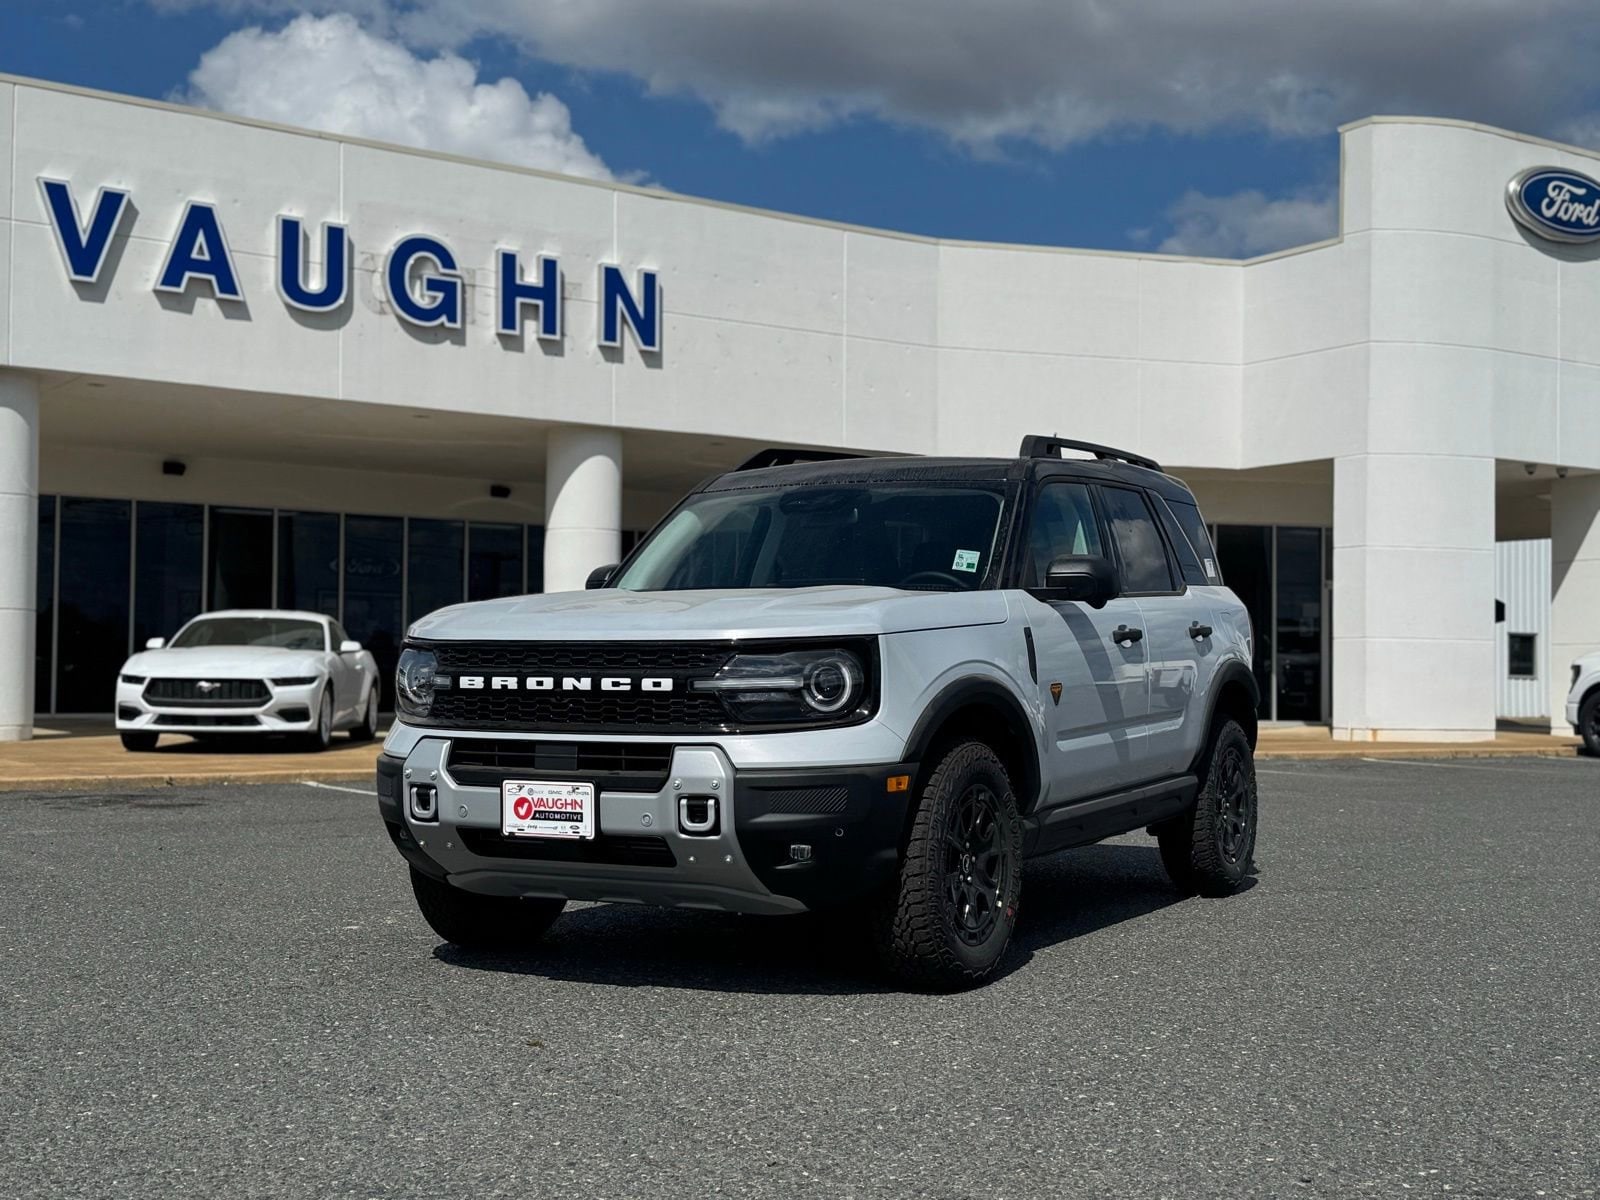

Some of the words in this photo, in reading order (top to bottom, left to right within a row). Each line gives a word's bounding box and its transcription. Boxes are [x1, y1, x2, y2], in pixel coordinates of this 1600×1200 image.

[1541, 180, 1600, 226] Ford
[37, 176, 662, 353] VAUGHN
[459, 676, 674, 692] BRONCO
[531, 797, 583, 810] VAUGHN
[535, 813, 582, 821] AUTOMOTIVE
